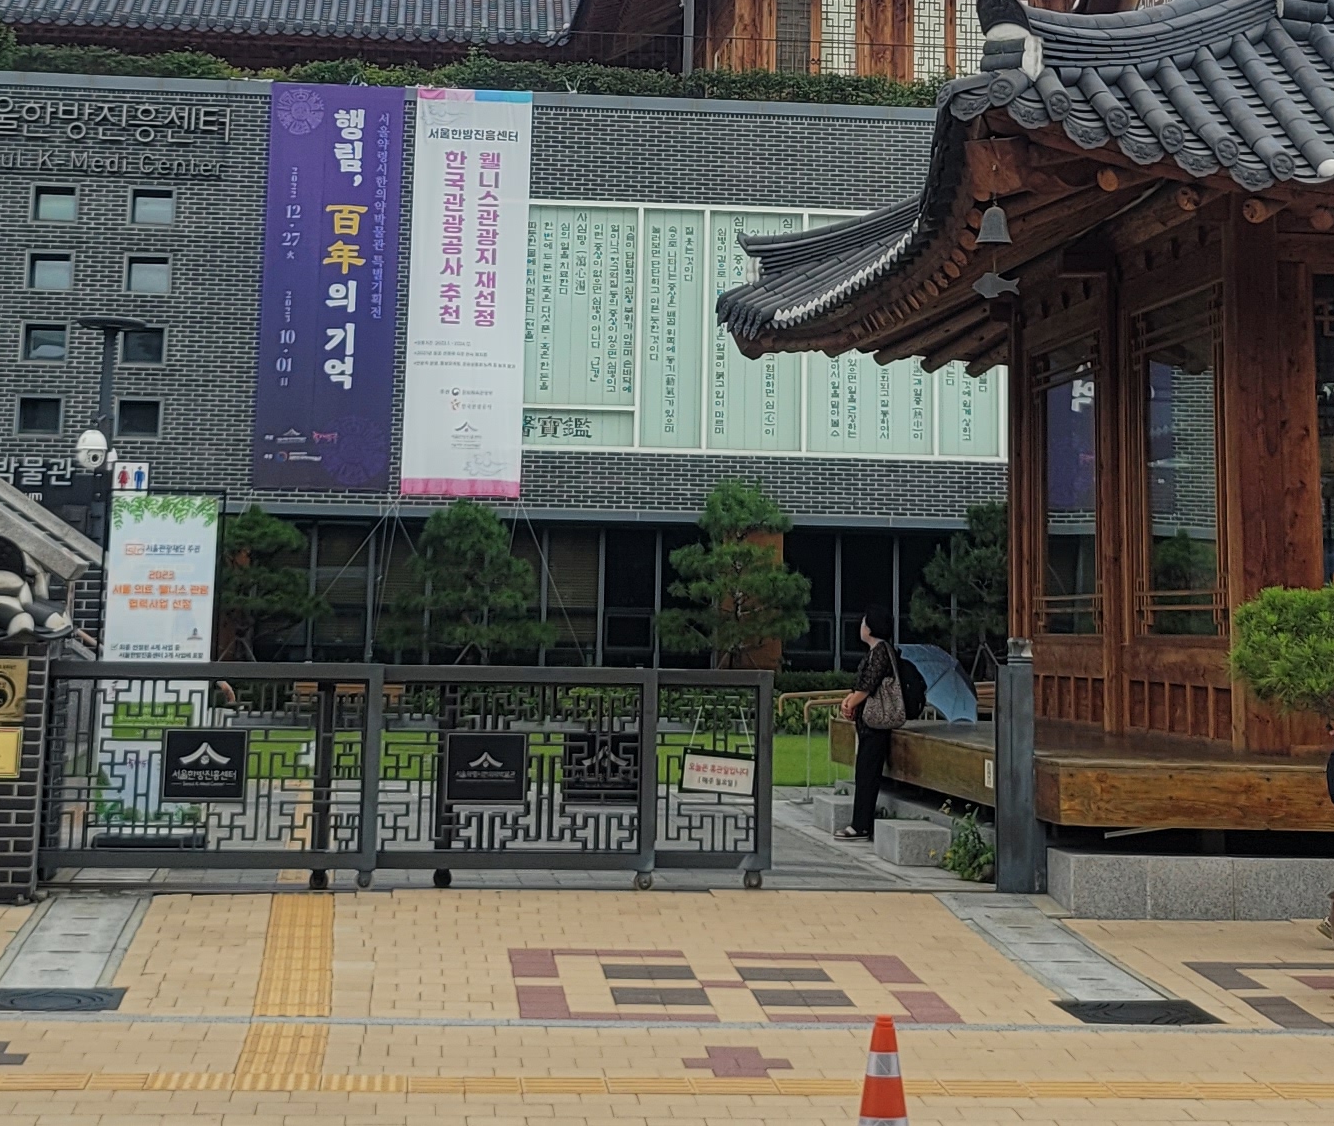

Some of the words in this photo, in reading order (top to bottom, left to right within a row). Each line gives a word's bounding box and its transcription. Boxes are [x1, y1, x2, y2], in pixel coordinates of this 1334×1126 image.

[334, 109, 366, 187] 행림,
[428, 127, 519, 142] 서울한방진흥센터
[38, 149, 127, 172] K-Medi
[138, 153, 229, 176] Center
[440, 150, 468, 276] 한국관광공사
[474, 152, 501, 266] 웰니스관광지
[439, 282, 462, 325] 추천
[473, 271, 497, 328] 재선정
[324, 323, 356, 390] 기억
[113, 584, 132, 595] 서울
[190, 585, 209, 596] 관광
[148, 570, 174, 580] 2023
[172, 770, 237, 781] 서울한방진흥센터
[689, 762, 708, 773] 오늘은
[710, 764, 749, 777] 휴관일입니다
